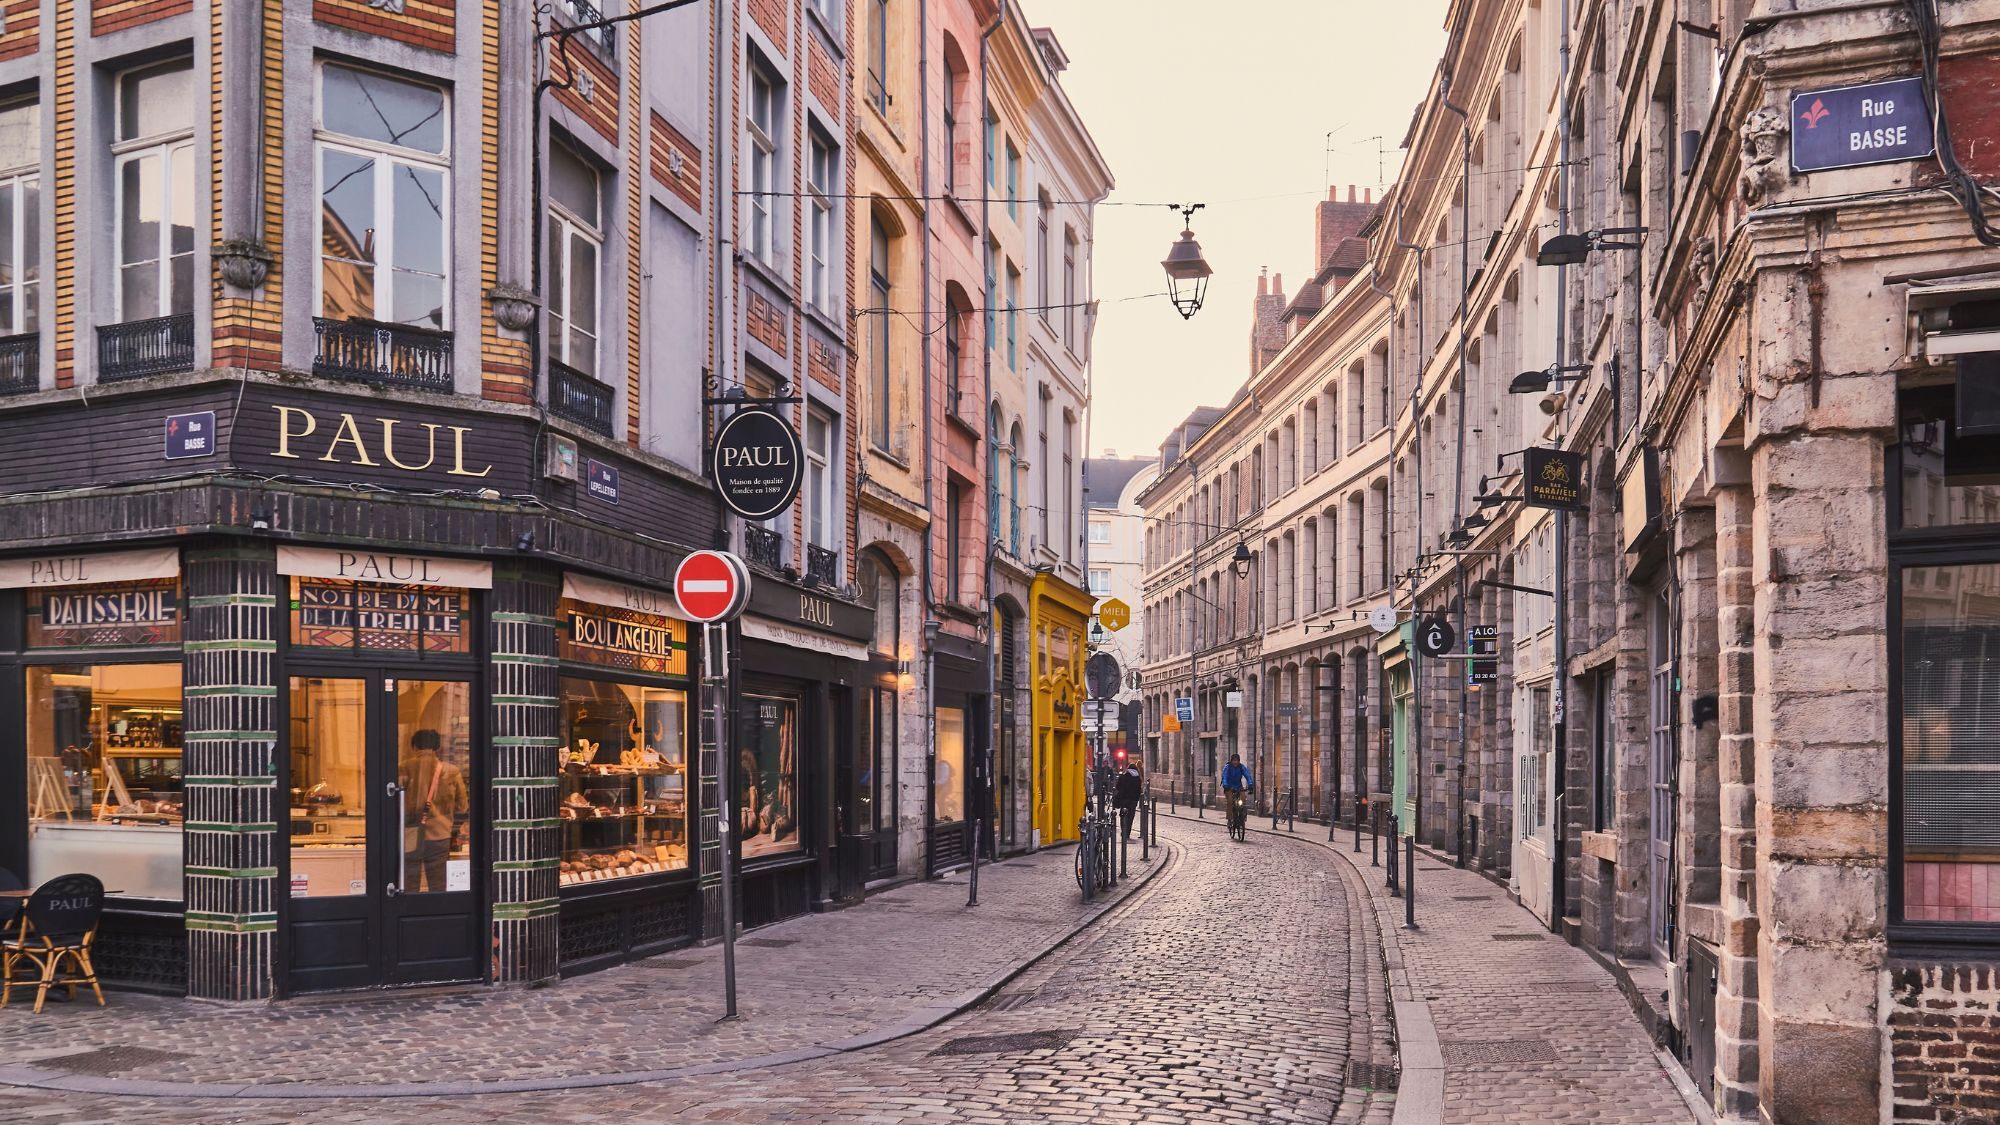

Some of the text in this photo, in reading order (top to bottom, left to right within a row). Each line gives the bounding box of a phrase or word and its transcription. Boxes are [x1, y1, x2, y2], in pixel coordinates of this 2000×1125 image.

[1861, 98, 1895, 118] Rue
[1849, 126, 1907, 151] BASSE
[188, 421, 201, 432] Rue
[184, 437, 205, 450] BASSE
[270, 405, 492, 477] PAUL
[723, 446, 789, 467] PAUL
[602, 470, 611, 482] Rue
[753, 477, 761, 485] de
[762, 477, 784, 486] qualité
[590, 480, 616, 497] LEPELLETIER
[732, 486, 754, 494] fondée
[30, 557, 90, 584] PAUL
[336, 552, 441, 583] PAUL
[50, 590, 176, 625] PATISSERIE
[303, 588, 389, 608] NOTRE
[624, 586, 661, 613] PAUL
[303, 608, 460, 632] DE LA TREILLE
[800, 594, 834, 627] PAUL
[1103, 607, 1126, 616] MIEL
[576, 615, 672, 655] BOULANGERIE
[1427, 622, 1442, 650] ê
[760, 705, 778, 719] PAUL
[49, 897, 93, 911] PAUL
